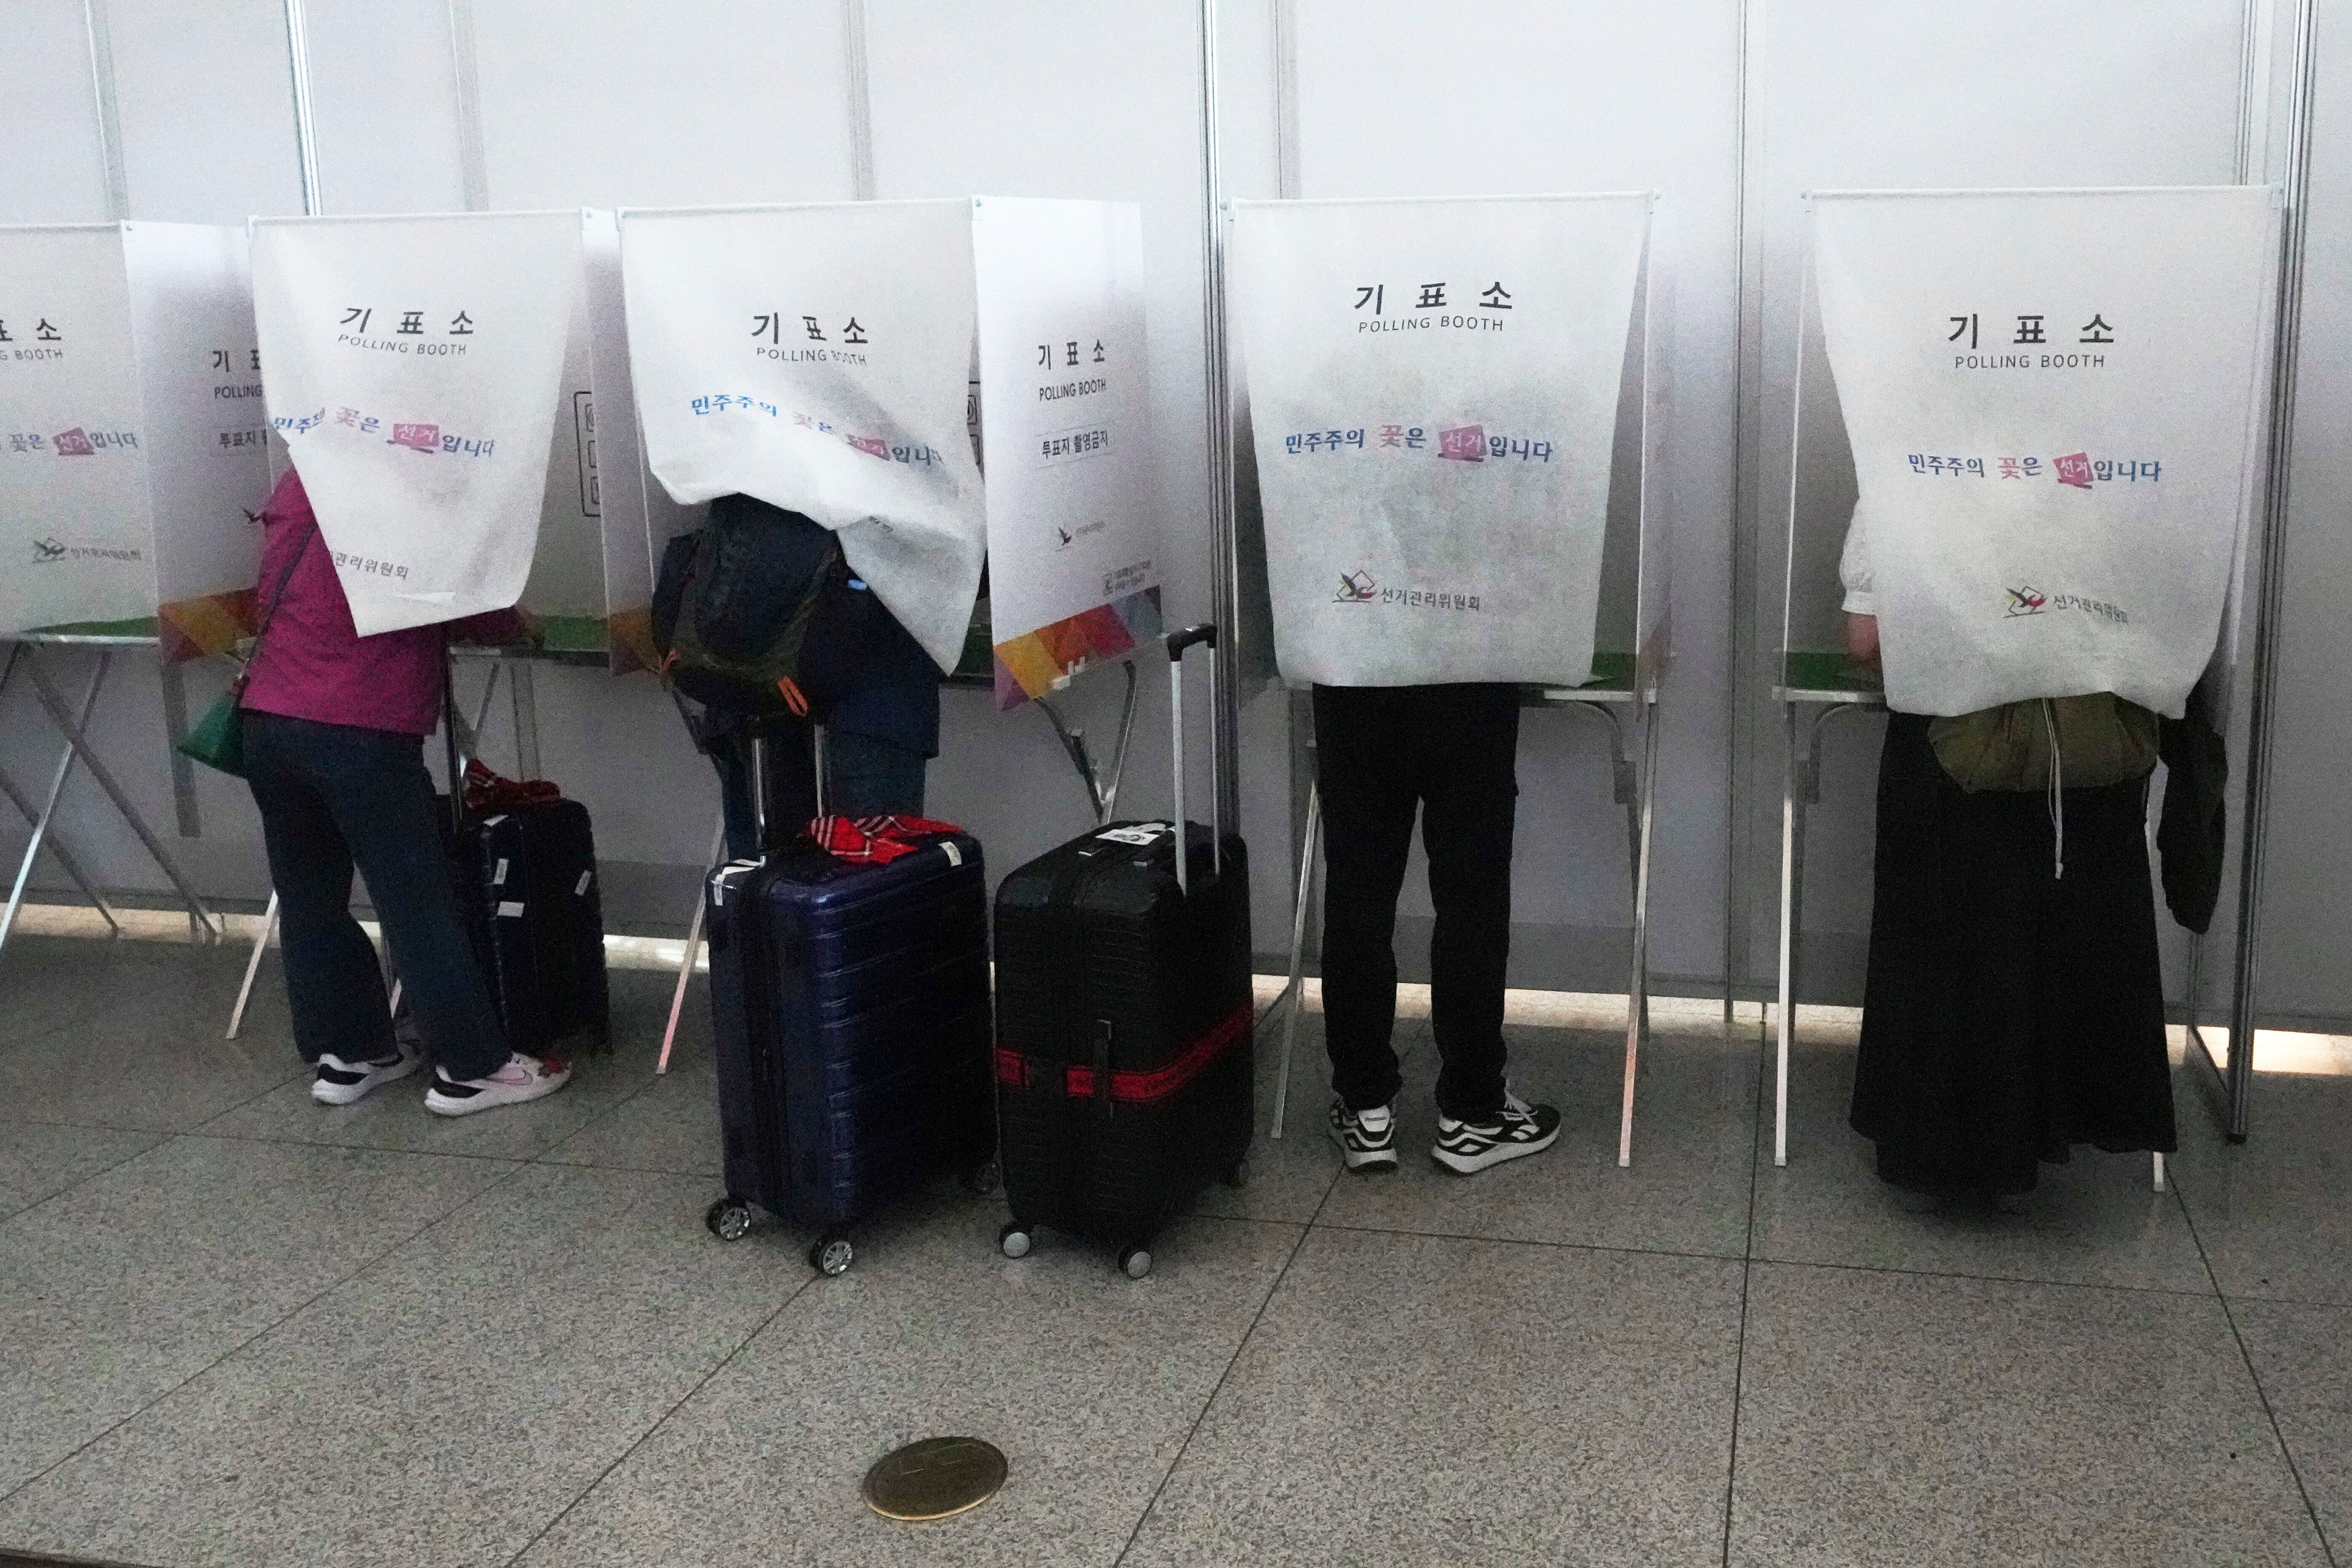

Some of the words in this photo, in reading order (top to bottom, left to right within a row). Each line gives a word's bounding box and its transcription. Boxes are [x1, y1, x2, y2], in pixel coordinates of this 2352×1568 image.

[1359, 317, 1430, 333] POLLING
[1441, 316, 1503, 332] BOOTH
[15, 349, 62, 360] BOOTH
[339, 334, 409, 353] POLLING
[417, 344, 466, 355] BOOTH
[757, 348, 826, 362] POLLING
[1955, 355, 2030, 369] POLLING
[2040, 354, 2105, 368] BOOTH
[214, 385, 263, 399] POLLING
[1039, 383, 1075, 401] POLLING
[1079, 379, 1106, 395] BOOTH
[691, 394, 777, 417] 민주주의
[1043, 436, 1070, 459] 투표지
[1285, 428, 1365, 454] 민주주의
[1380, 425, 1427, 449] 꽃은
[1908, 454, 1984, 477] 민주주의
[1997, 457, 2042, 479] 꽃은
[331, 551, 409, 580] 관리위원회
